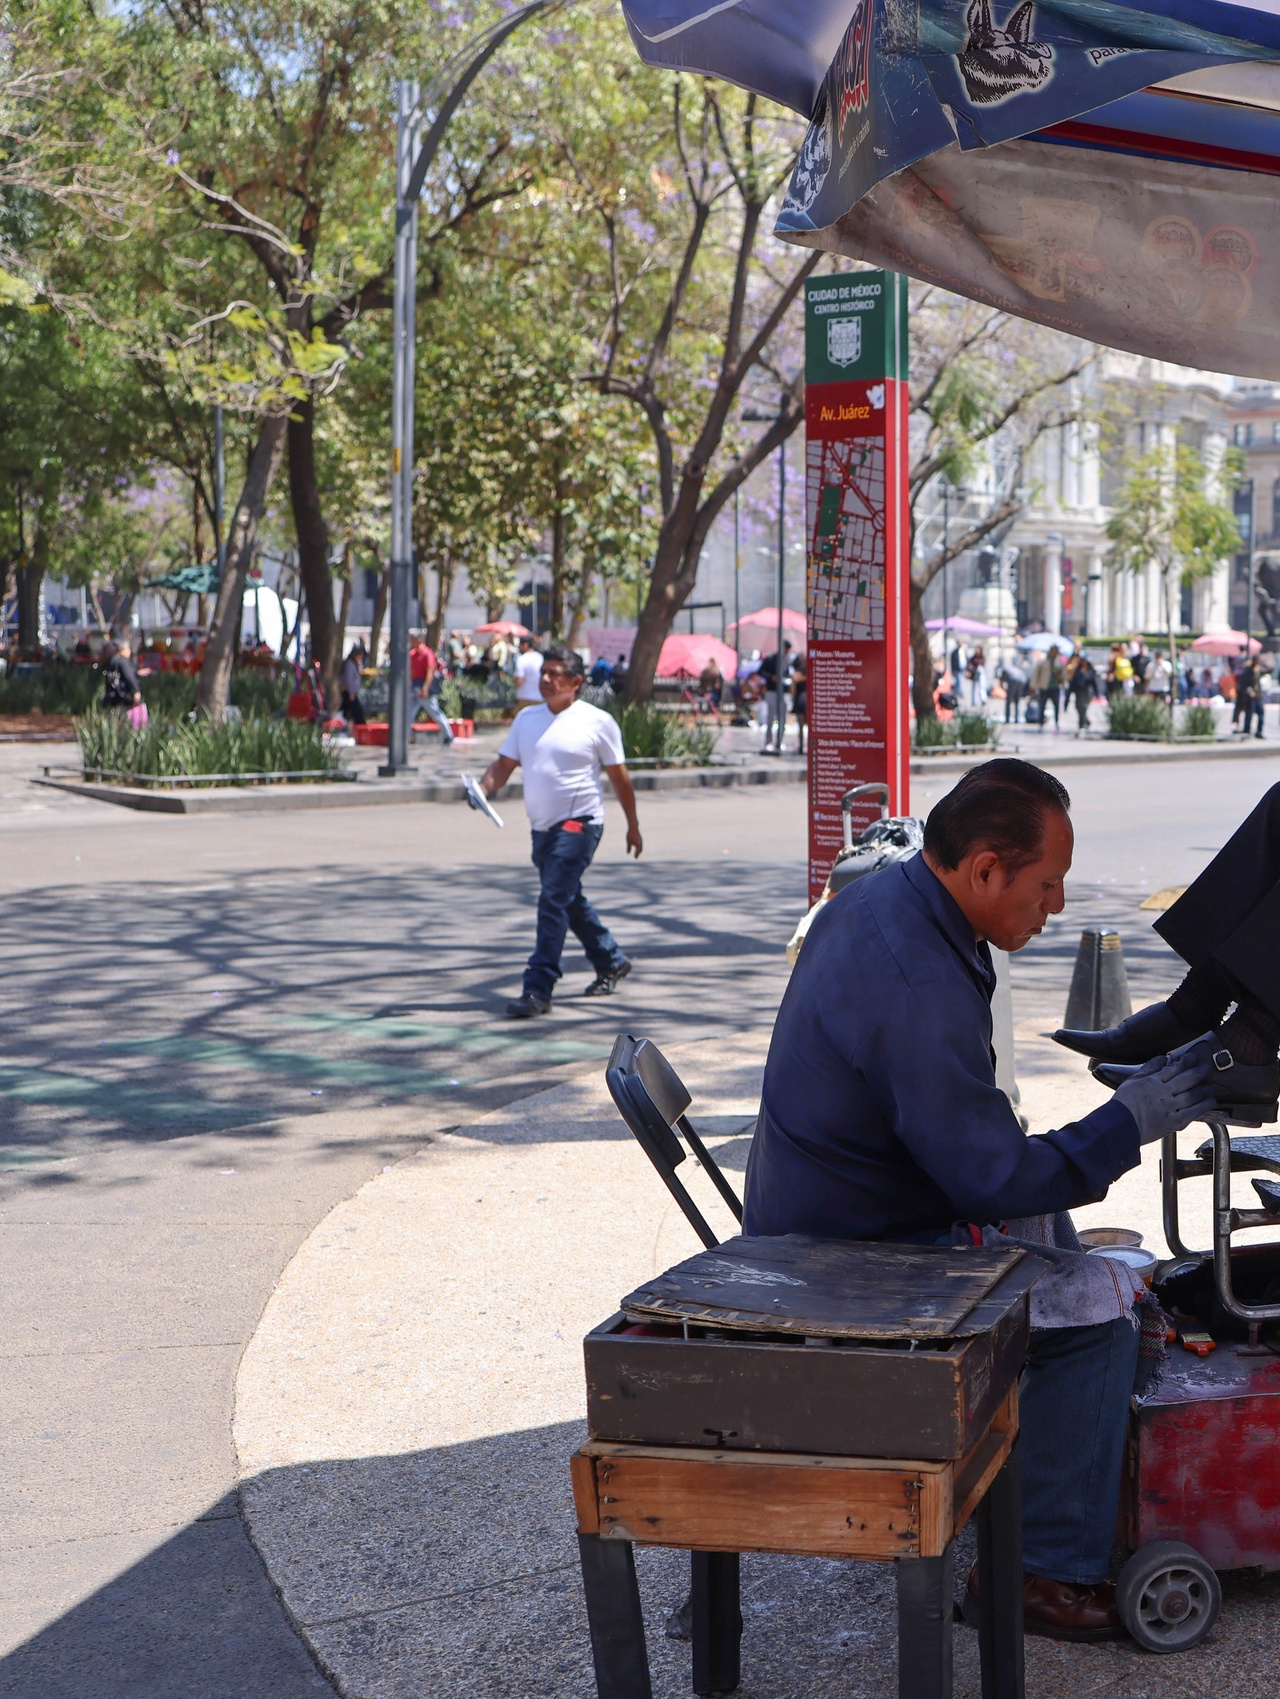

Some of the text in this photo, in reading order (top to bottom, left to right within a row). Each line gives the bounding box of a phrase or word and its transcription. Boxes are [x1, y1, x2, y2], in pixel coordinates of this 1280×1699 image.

[808, 283, 881, 302] CIUDAD DE MÉXICO
[814, 299, 875, 315] CENTRO HISTÓRICO
[820, 403, 870, 422] Av. Juárez
